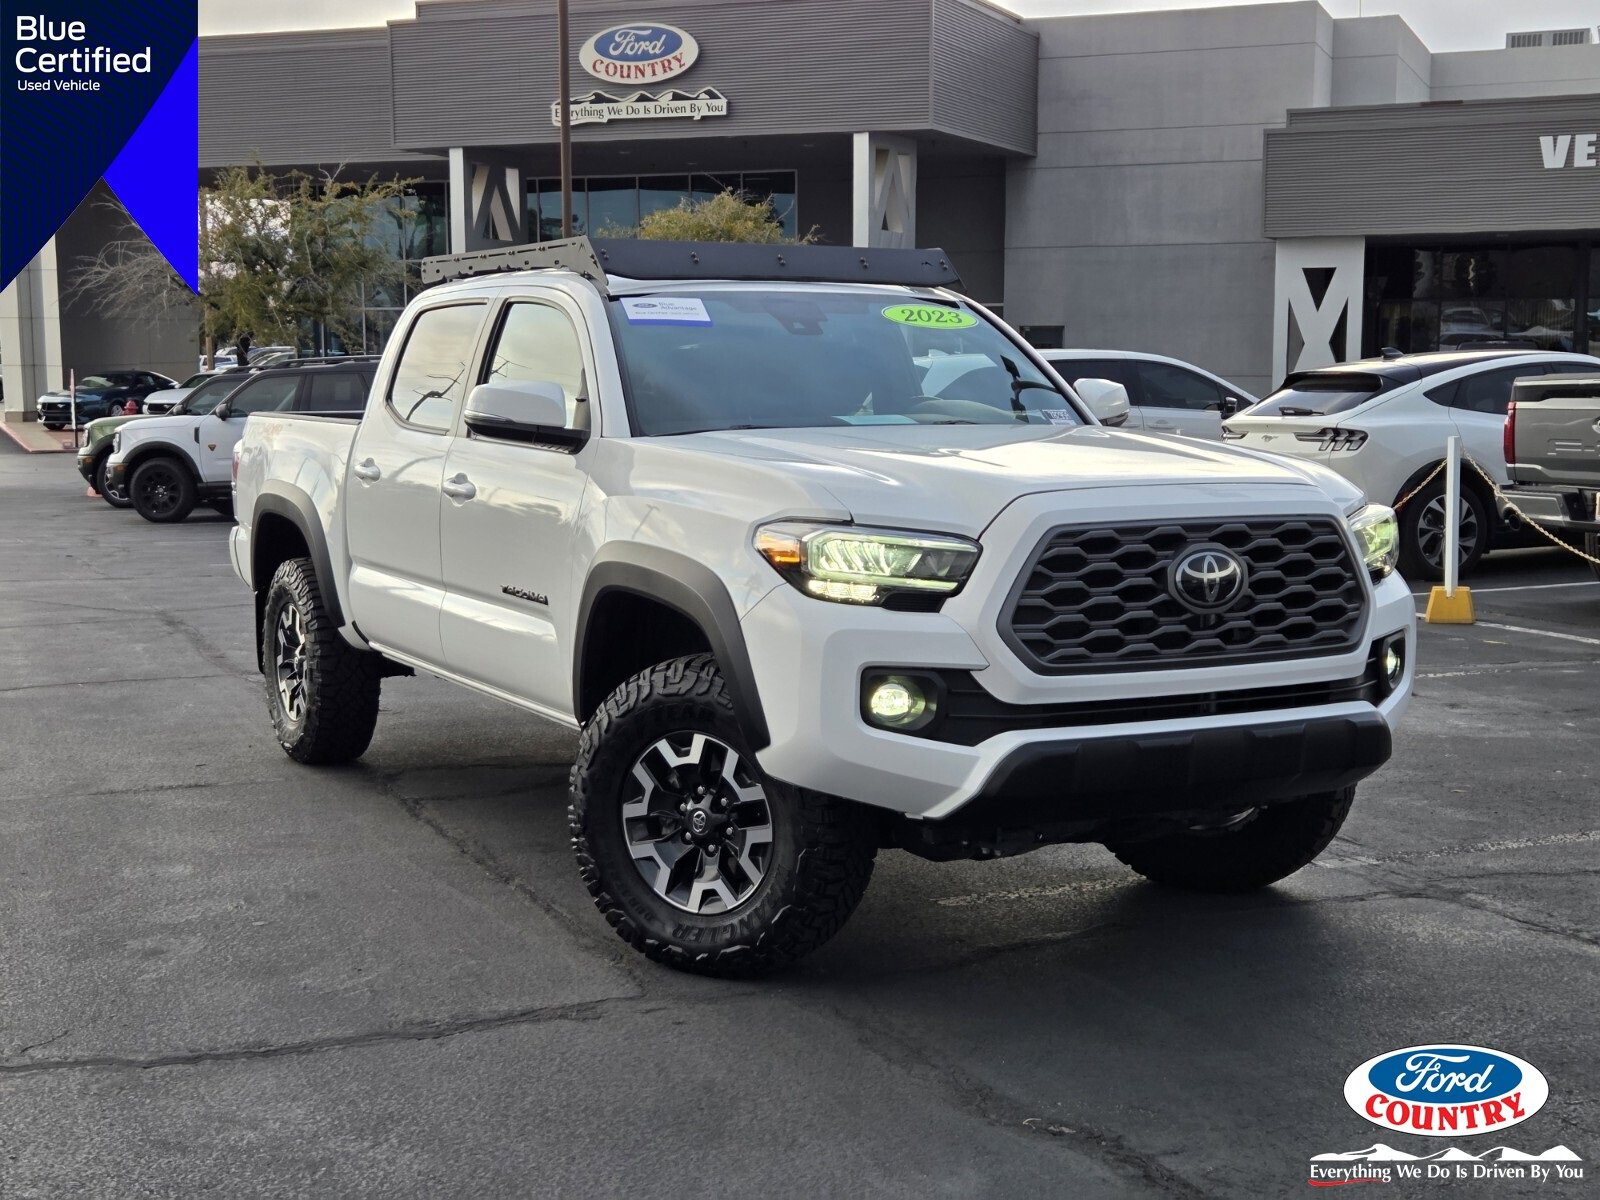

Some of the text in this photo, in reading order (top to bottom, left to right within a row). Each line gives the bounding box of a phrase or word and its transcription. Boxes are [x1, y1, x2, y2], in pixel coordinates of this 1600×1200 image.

[608, 28, 667, 56] Ford
[592, 52, 686, 79] COUNTRY
[554, 102, 723, 119] Erything We Do Is Driven By You
[1539, 133, 1597, 169] VE
[900, 308, 963, 324] 2023
